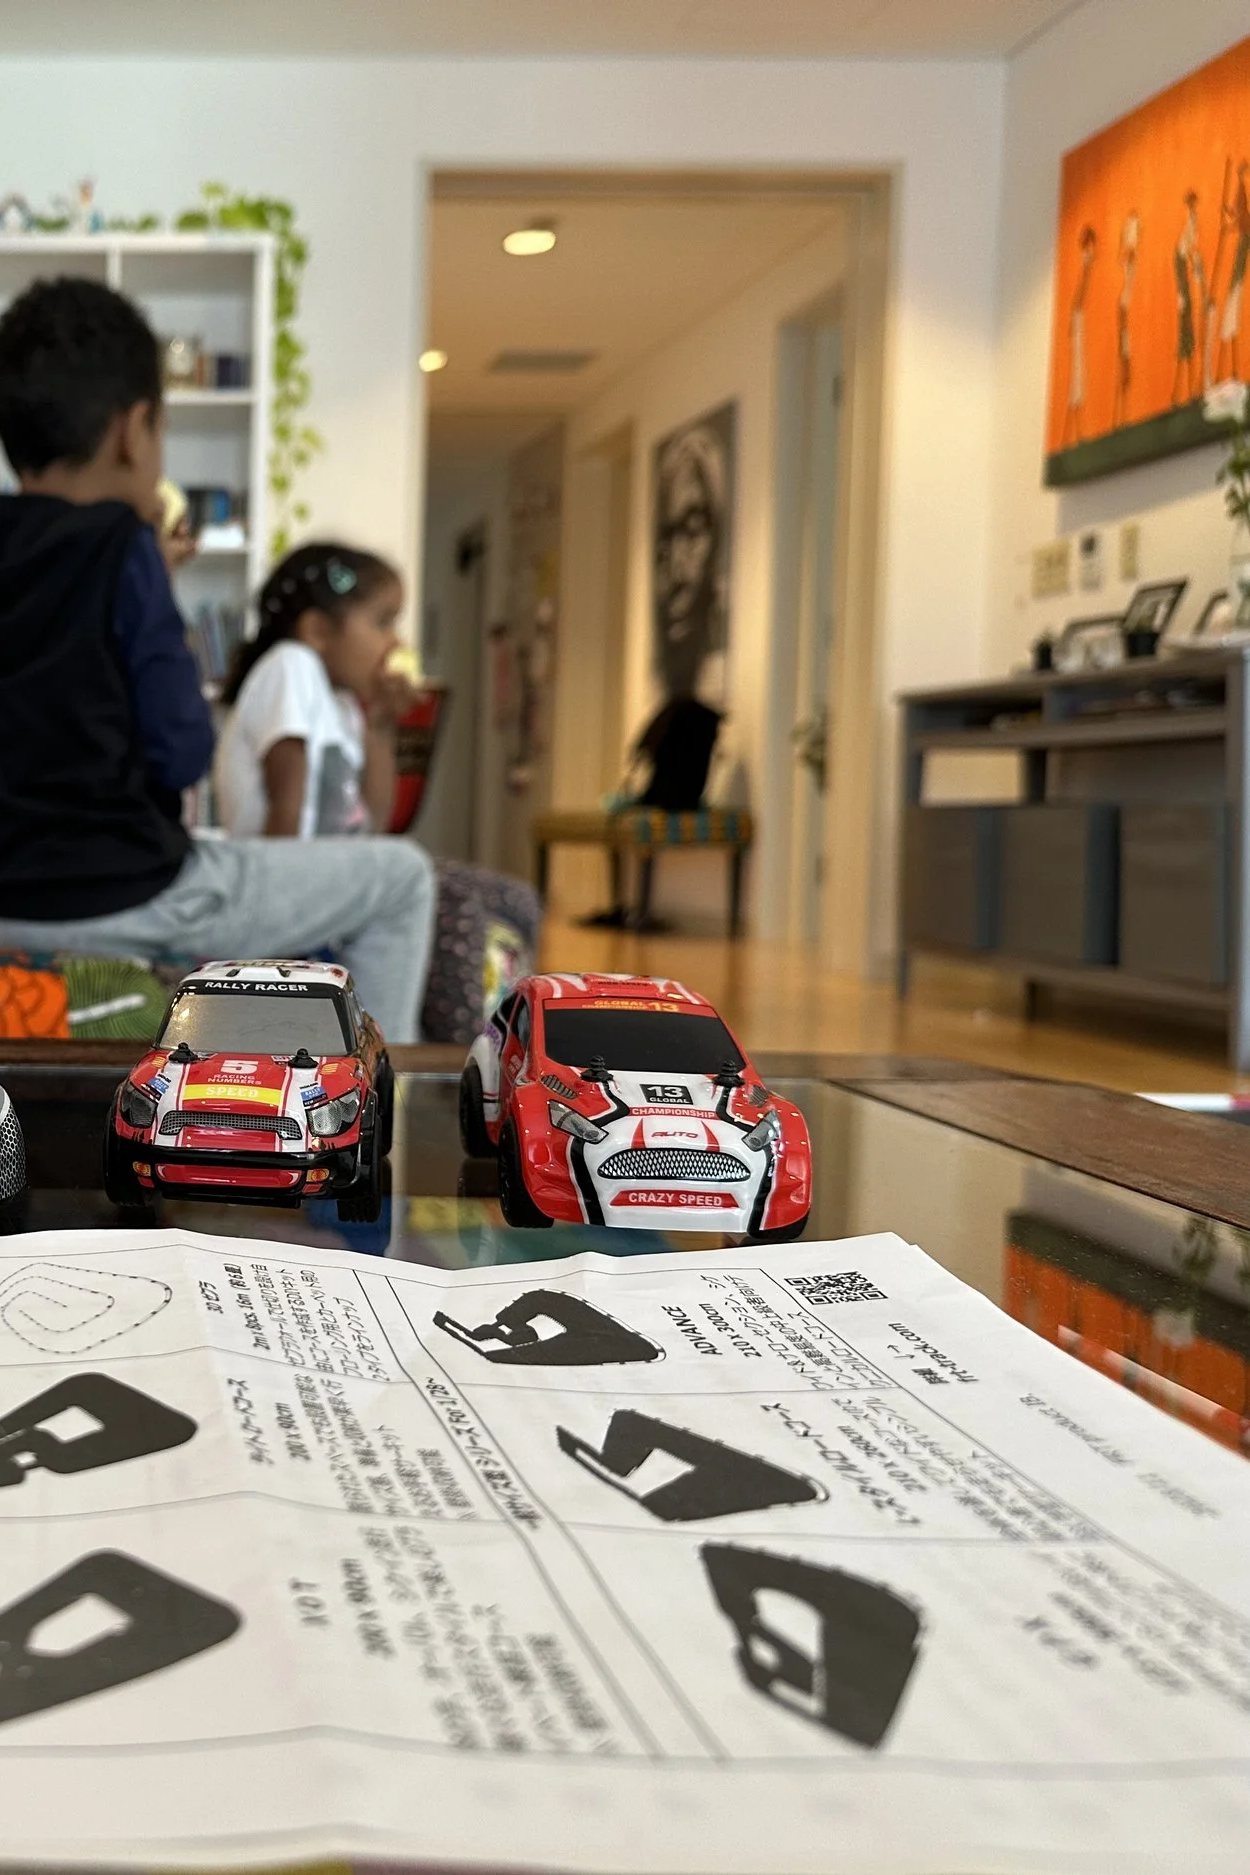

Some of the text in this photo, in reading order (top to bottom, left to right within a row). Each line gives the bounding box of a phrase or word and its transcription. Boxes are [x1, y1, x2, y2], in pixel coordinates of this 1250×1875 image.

[204, 981, 309, 992] RALLY RACER
[648, 1001, 680, 1013] 13
[220, 1059, 259, 1075] 5
[205, 1086, 260, 1098] SPEED
[647, 1086, 683, 1098] 13
[631, 1107, 715, 1119] CHAMPIONSHIP
[651, 1131, 699, 1139] AUTO
[628, 1192, 722, 1206] CRAZY SPEED
[699, 1303, 735, 1333] 300cm
[661, 1305, 723, 1356] ADVANCE
[732, 1341, 762, 1358] 210
[888, 1323, 979, 1383] frt-track.com
[446, 1407, 470, 1424] For
